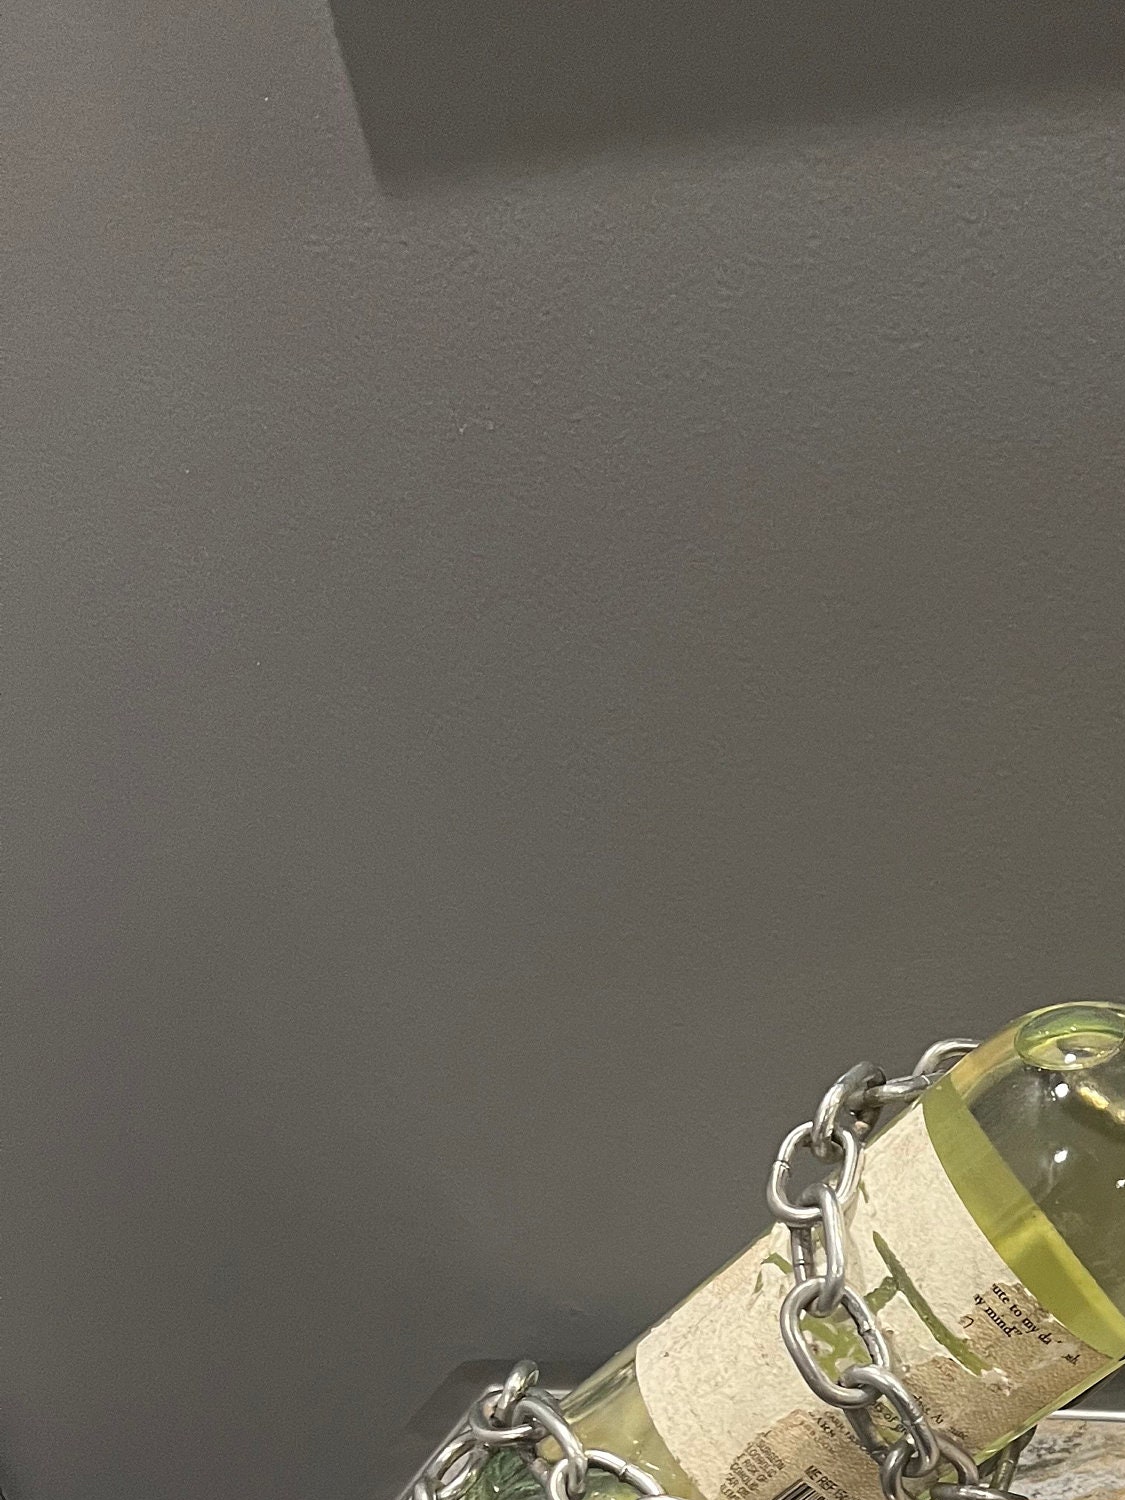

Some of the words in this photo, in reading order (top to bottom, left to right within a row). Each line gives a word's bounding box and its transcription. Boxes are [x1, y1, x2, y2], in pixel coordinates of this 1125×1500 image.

[992, 1283, 1010, 1304] ute
[1009, 1304, 1022, 1317] to
[1022, 1318, 1040, 1333] my
[884, 1413, 900, 1423] of
[817, 1476, 839, 1491] REF
